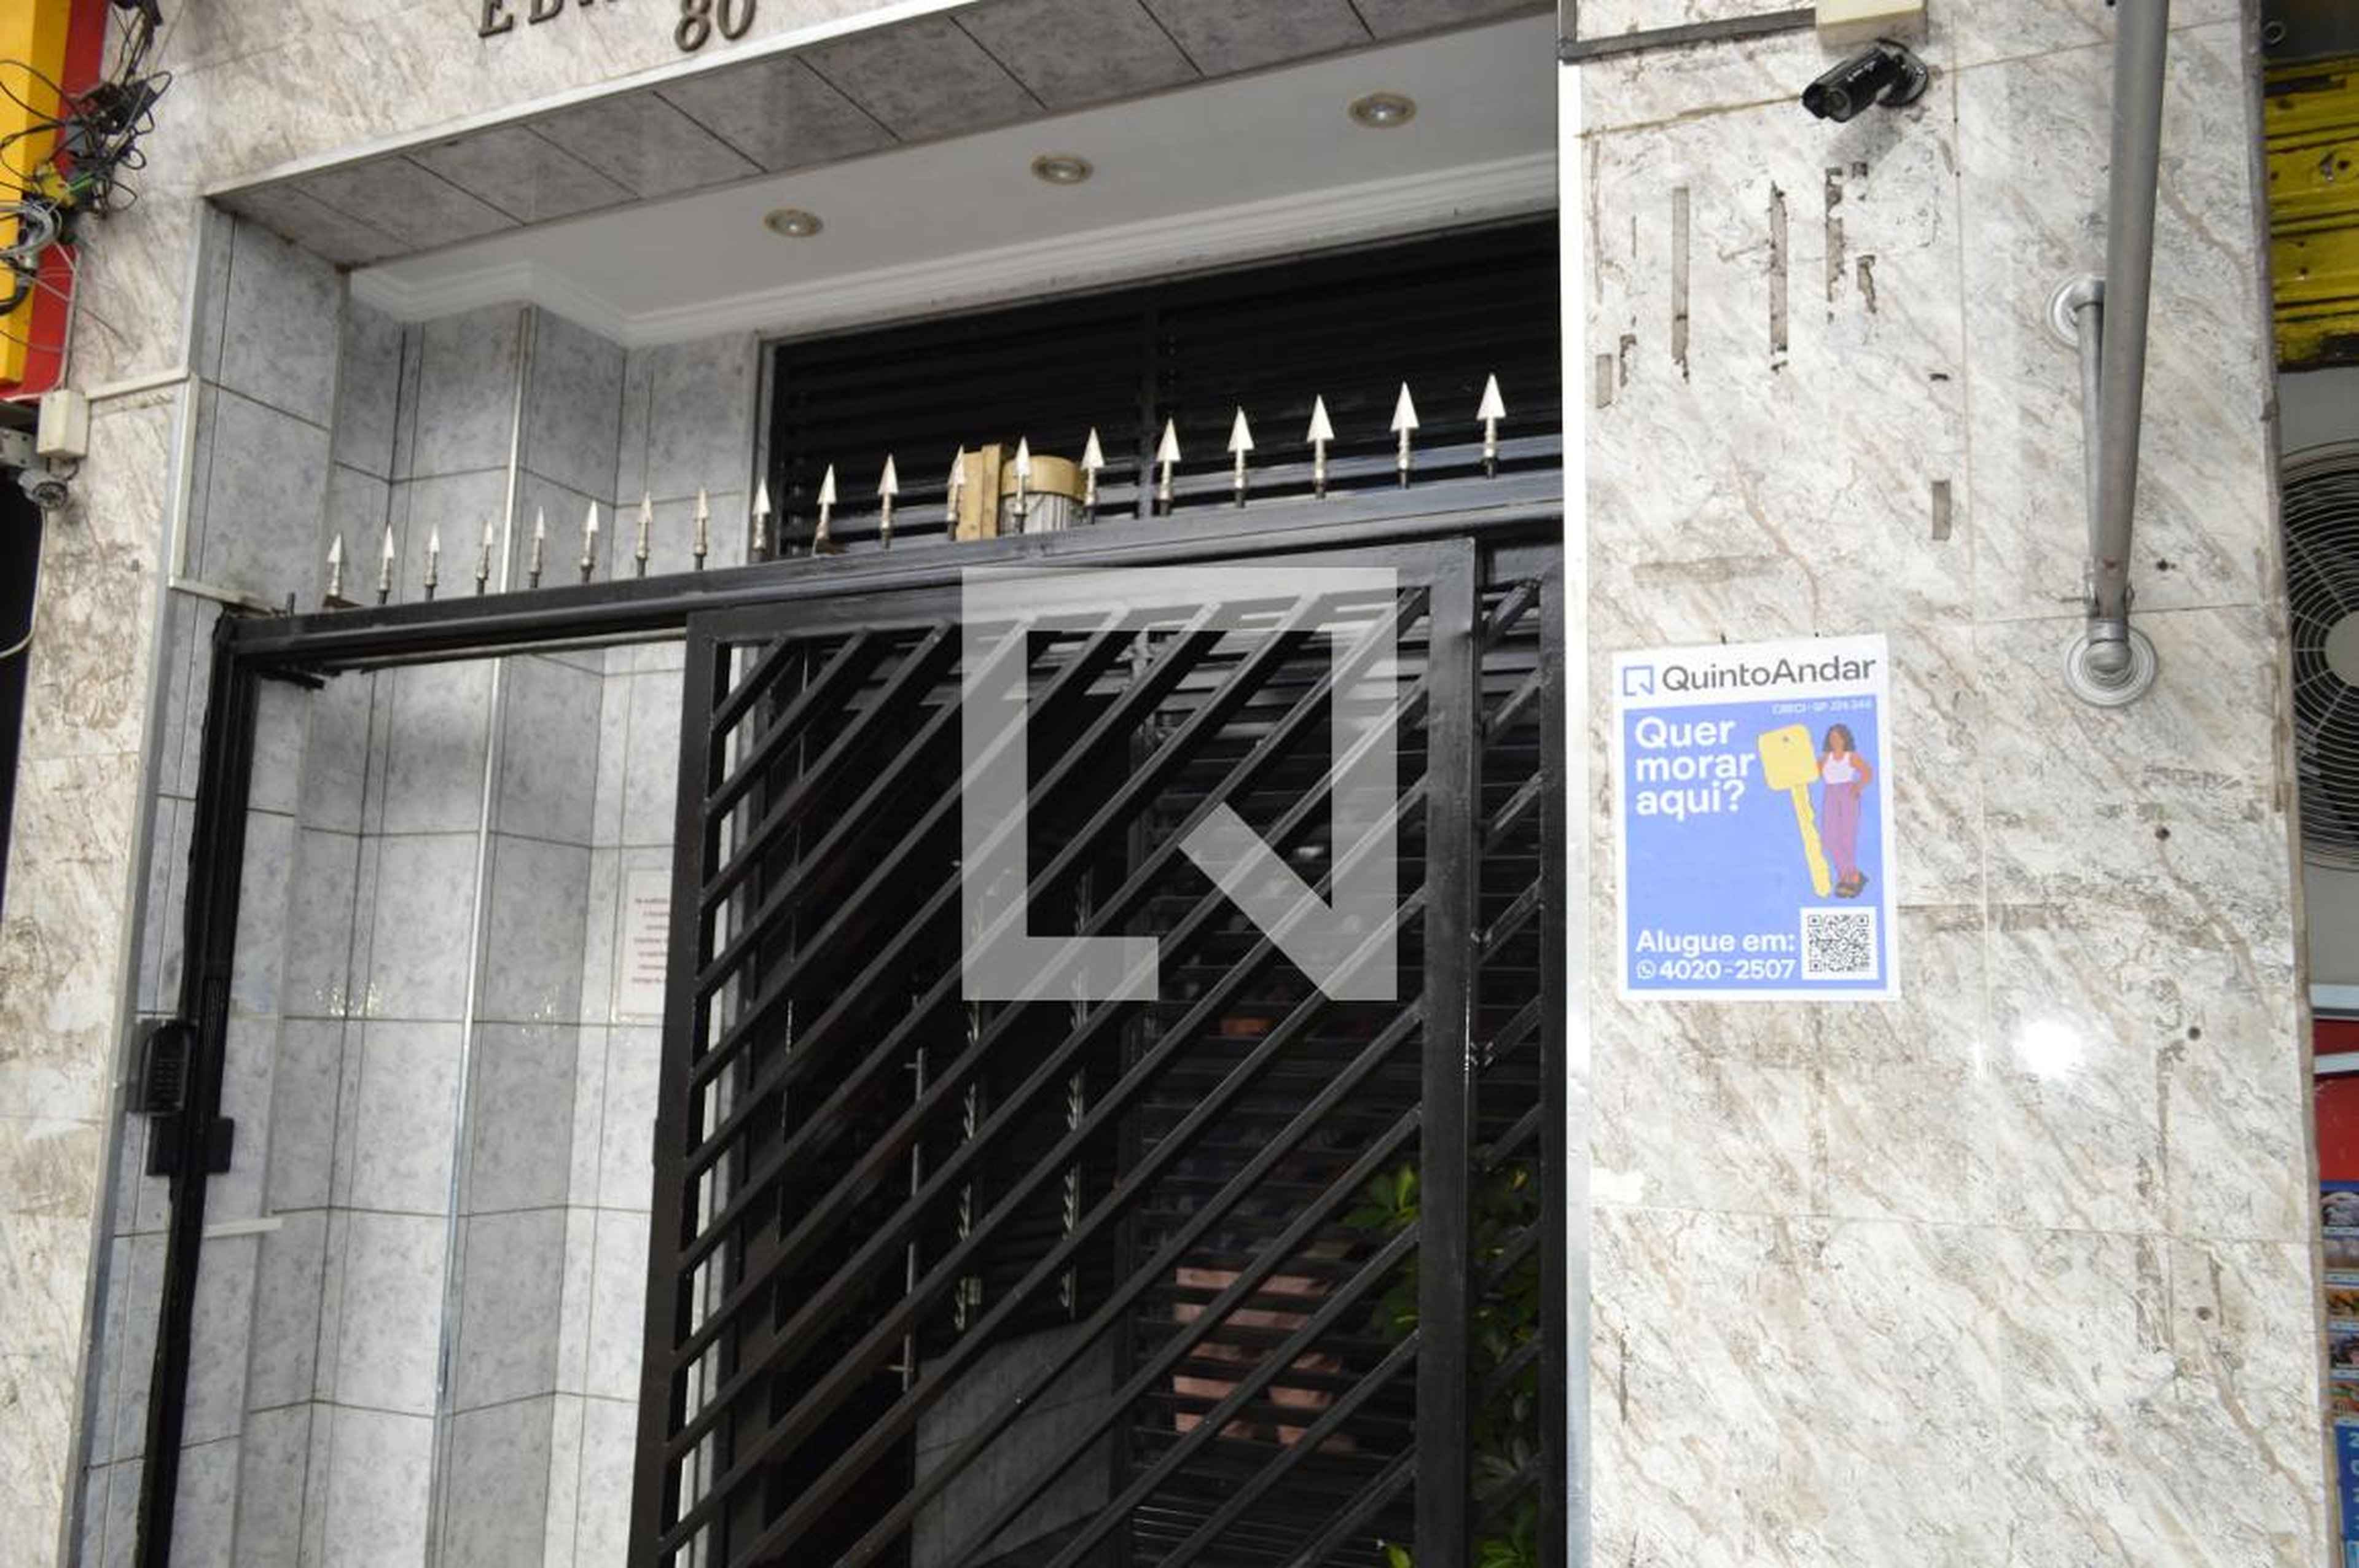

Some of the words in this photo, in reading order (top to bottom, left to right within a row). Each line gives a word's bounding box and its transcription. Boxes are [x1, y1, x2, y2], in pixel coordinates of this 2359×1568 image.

[675, 0, 757, 52] 80
[1662, 655, 1876, 692] QuintoAndar
[1634, 716, 1736, 749] Quer
[1635, 752, 1755, 782] morar
[1635, 779, 1746, 821] aqui?
[1635, 929, 1735, 958] Alugue
[1742, 934, 1796, 953] em:
[1660, 959, 1798, 980] 4020-2507
